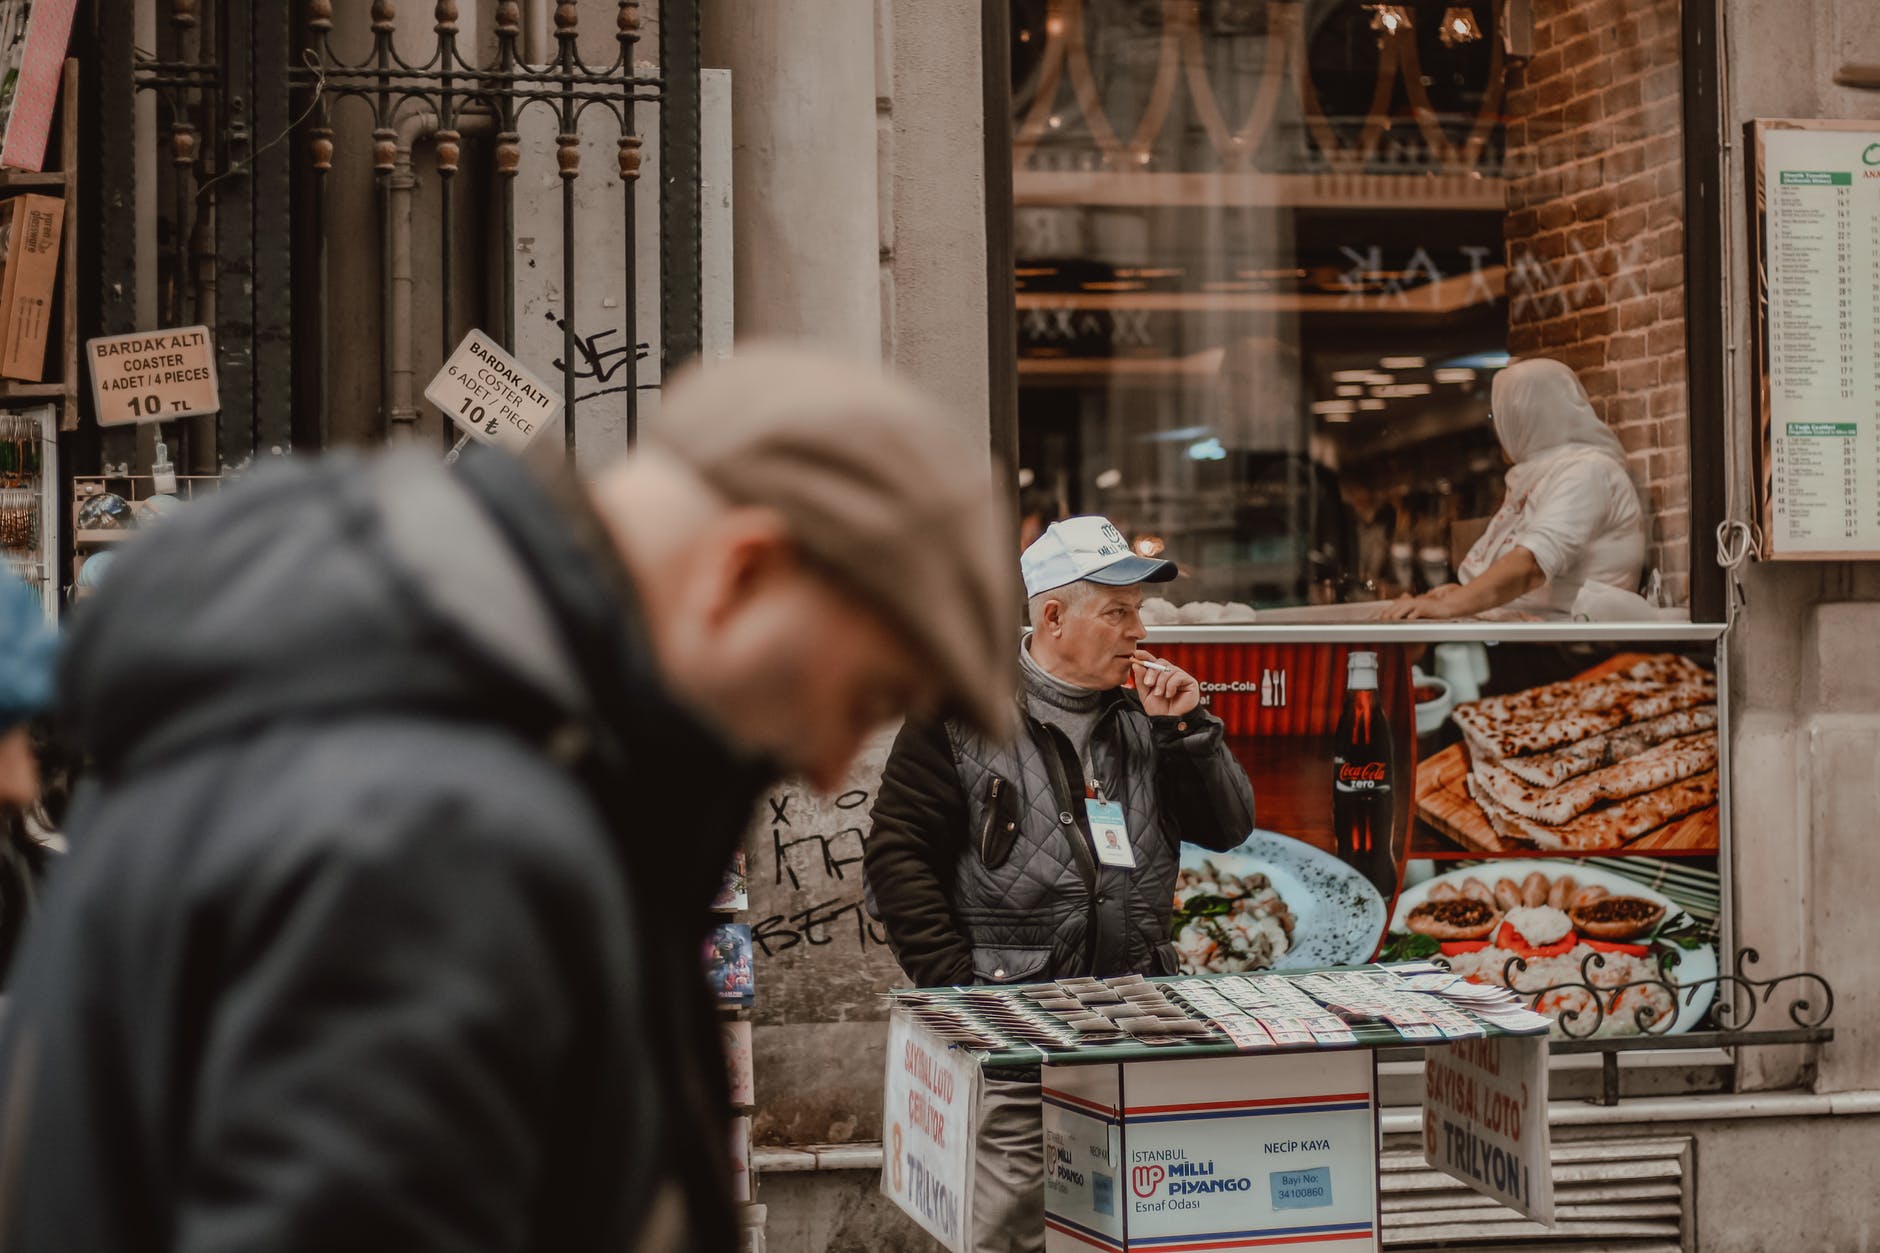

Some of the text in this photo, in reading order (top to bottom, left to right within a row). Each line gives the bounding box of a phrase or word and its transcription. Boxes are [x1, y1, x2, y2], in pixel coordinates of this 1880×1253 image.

[97, 333, 204, 358] BARDAK ALTI
[124, 354, 184, 372] COASTER
[102, 381, 108, 392] 4
[112, 376, 144, 390] ADET
[154, 374, 162, 384] 4
[165, 367, 210, 384] PIECES
[470, 342, 550, 408] BARDAK ALTI
[478, 368, 523, 408] COSTER
[128, 395, 192, 416] 10 TL
[448, 366, 458, 376] 6
[457, 374, 492, 400] ADET
[500, 405, 534, 435] PIECE
[460, 397, 485, 424] 10
[1200, 681, 1256, 692] Coca-Cola
[1350, 780, 1375, 788] zero
[934, 1060, 954, 1105] LOTO
[1132, 1148, 1187, 1162] İSTANBUL
[1264, 1140, 1330, 1154] NECİP KAYA
[1426, 1108, 1437, 1155] 6
[1444, 1120, 1520, 1200] TRİLYON
[1168, 1160, 1214, 1178] MİLLİ
[892, 1120, 958, 1240] 8 TRİLYON
[1169, 1178, 1251, 1196] PİYANGO
[1282, 1174, 1318, 1186] Bayi No:
[1279, 1187, 1324, 1200] 34100860
[1136, 1199, 1200, 1212] Esnaf Odası
